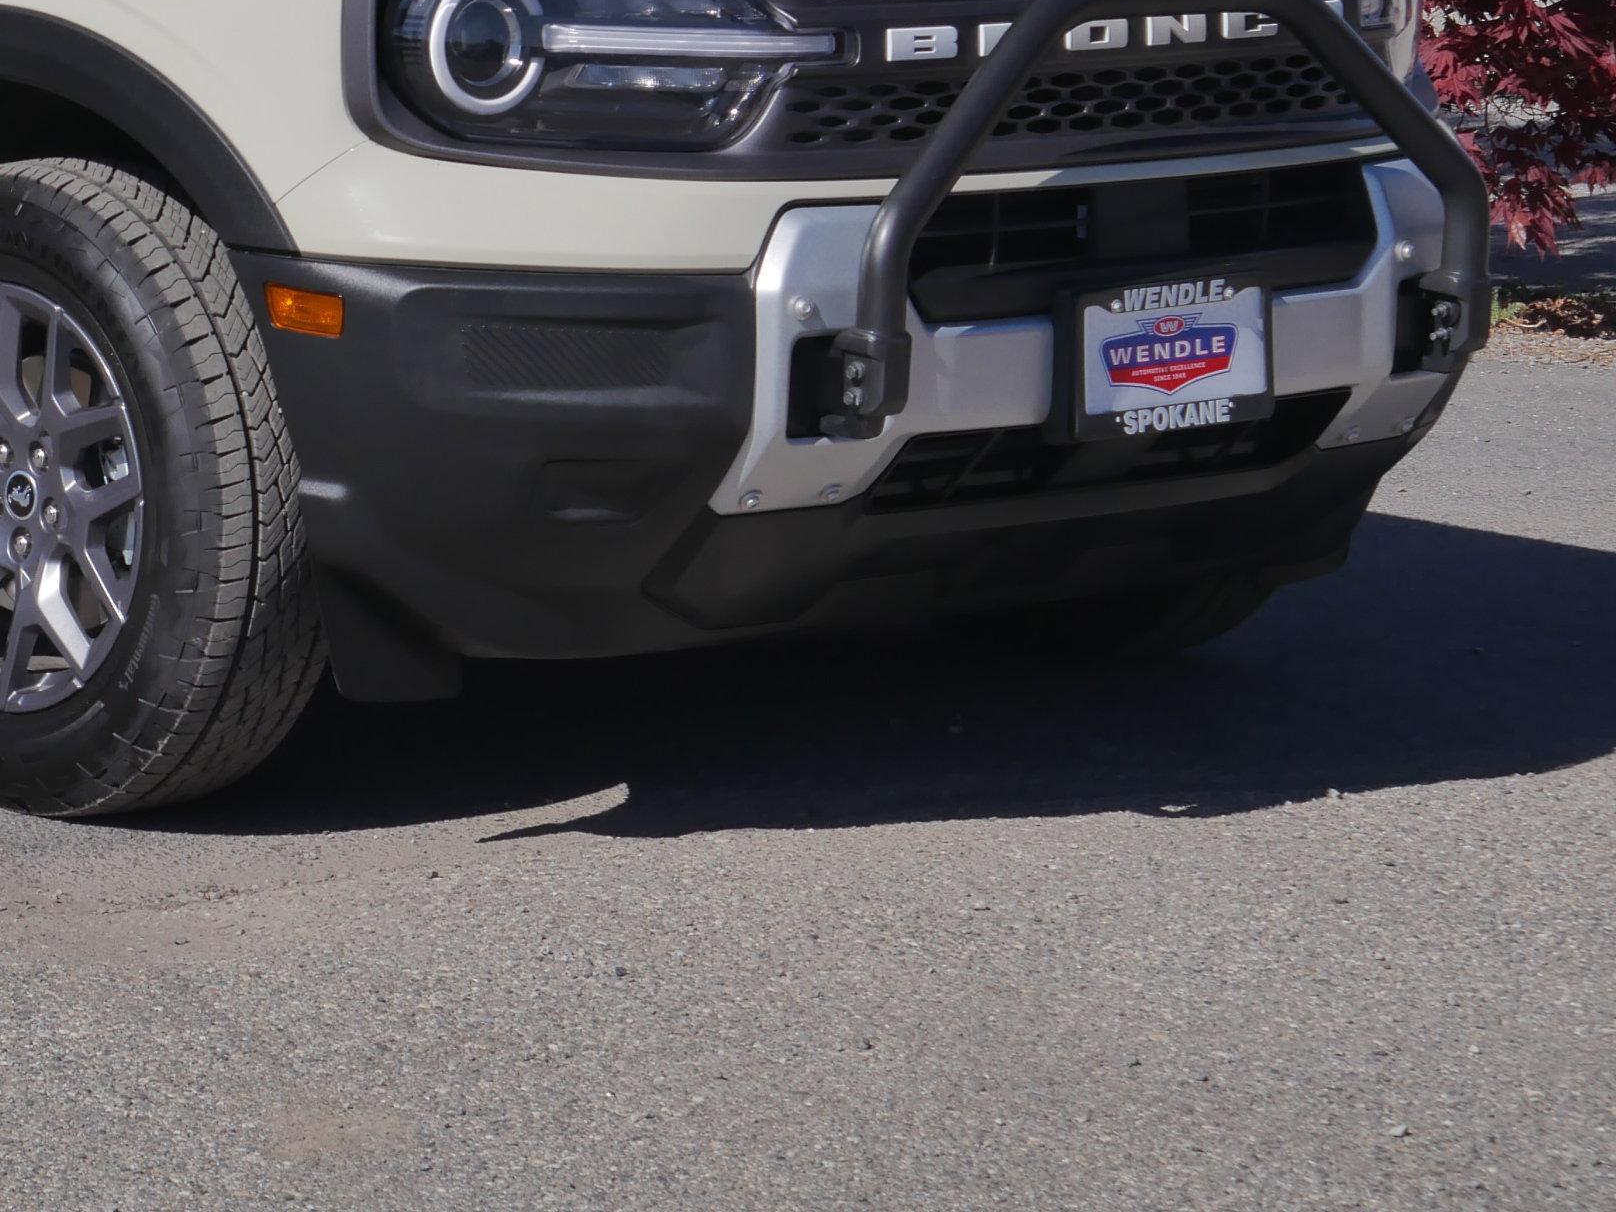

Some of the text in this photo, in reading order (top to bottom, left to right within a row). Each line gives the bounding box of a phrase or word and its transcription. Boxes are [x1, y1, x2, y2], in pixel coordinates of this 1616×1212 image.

[1123, 279, 1225, 312] WENDLE
[1110, 336, 1226, 366] WENDLE
[1124, 398, 1230, 435] SPOKANE
